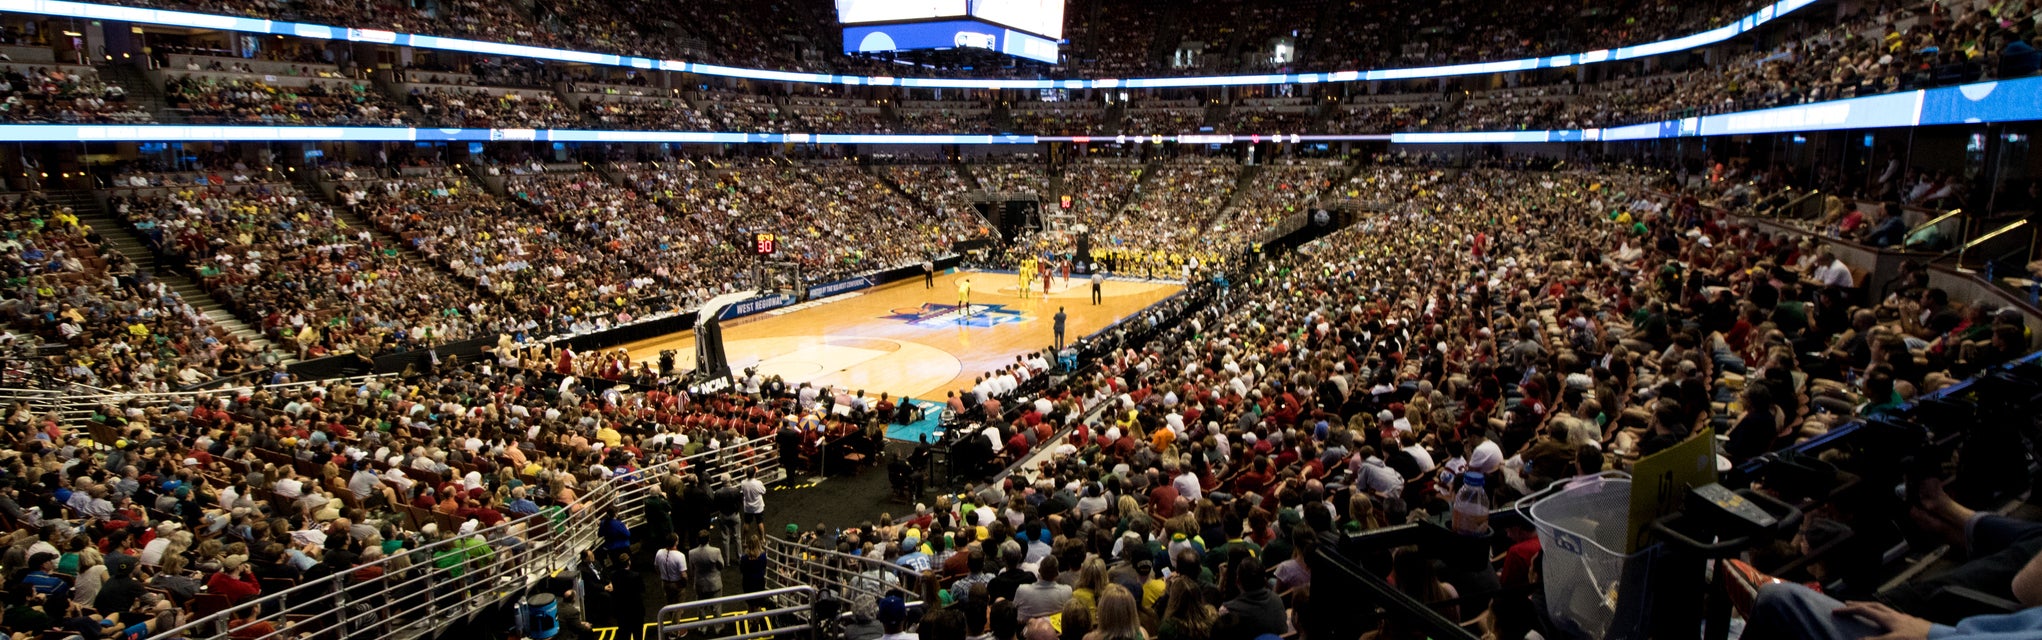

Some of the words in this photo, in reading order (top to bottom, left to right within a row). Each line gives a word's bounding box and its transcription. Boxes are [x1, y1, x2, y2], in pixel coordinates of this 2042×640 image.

[758, 241, 772, 253] 30
[736, 302, 754, 315] WEST
[754, 296, 783, 311] REGIONAL
[700, 375, 729, 395] NCAA
